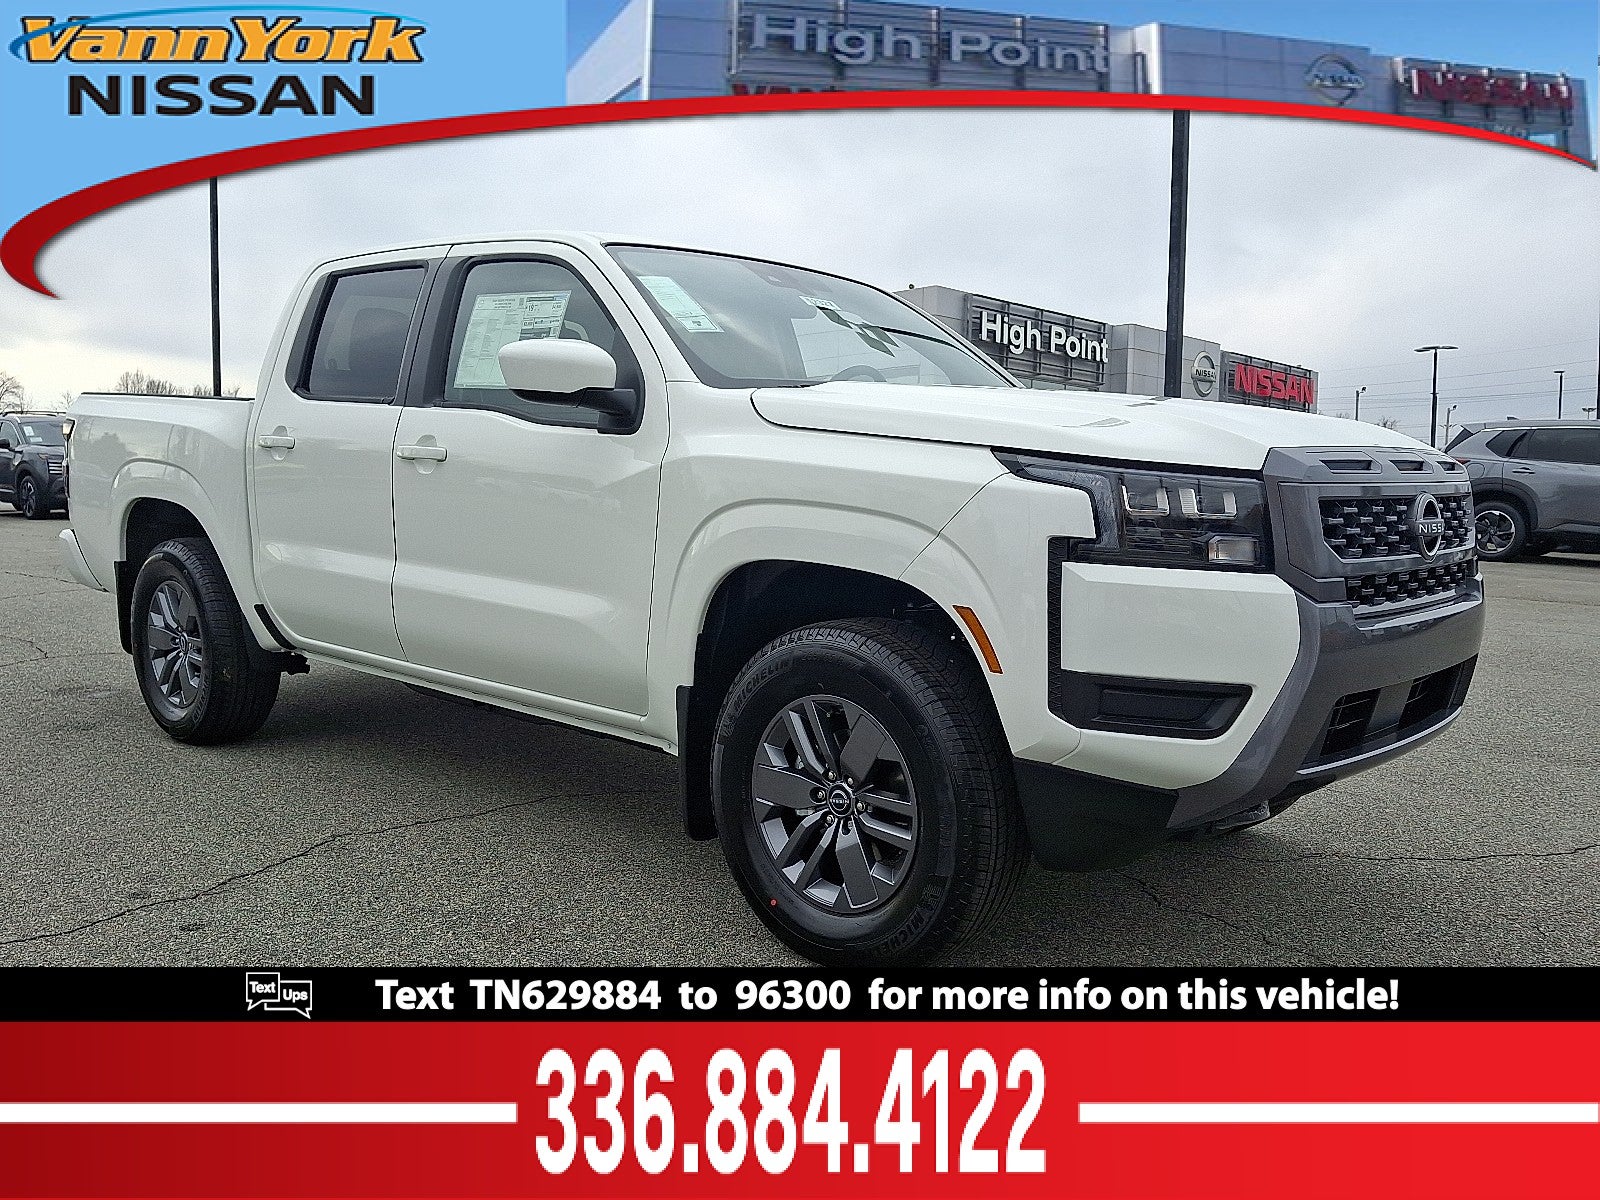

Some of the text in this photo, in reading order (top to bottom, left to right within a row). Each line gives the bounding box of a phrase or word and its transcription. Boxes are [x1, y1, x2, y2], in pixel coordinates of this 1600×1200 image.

[981, 310, 1108, 362] High Point
[1233, 363, 1314, 404] NISSAN
